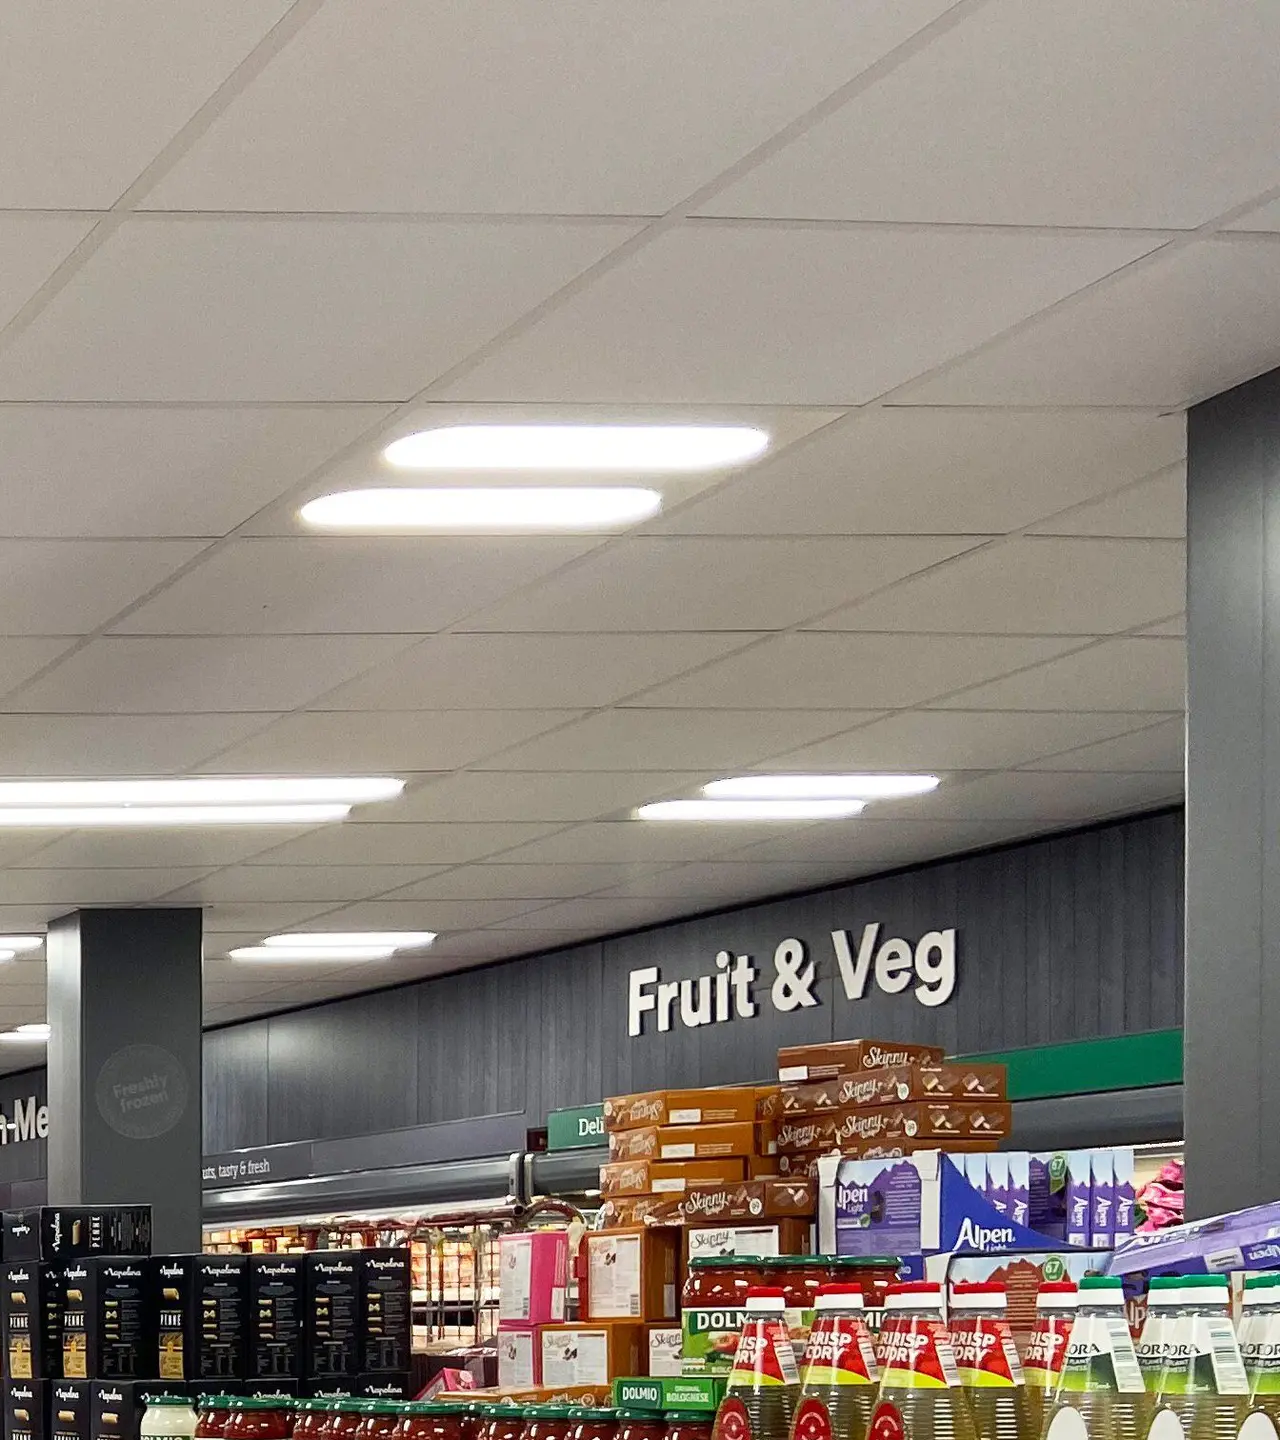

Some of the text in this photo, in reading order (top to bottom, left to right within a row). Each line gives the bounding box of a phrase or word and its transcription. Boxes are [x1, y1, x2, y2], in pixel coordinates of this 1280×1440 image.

[628, 921, 957, 1037] Fruit & Veg
[863, 1046, 915, 1068] Skinny
[112, 1073, 168, 1099] Freshly
[840, 1079, 882, 1102] Skinny
[120, 1089, 170, 1114] frozen
[778, 1124, 820, 1147] Skinny
[842, 1113, 887, 1138] Skinny
[202, 1164, 217, 1181] uts,
[218, 1162, 239, 1179] tasty
[248, 1159, 270, 1175] fresh
[686, 1191, 731, 1215] Skinny
[1073, 1196, 1089, 1227] Alpen
[1096, 1196, 1112, 1227] Alpen
[1118, 1195, 1133, 1226] Alpen
[92, 1215, 101, 1249] PENNE
[691, 1230, 731, 1248] Skinny
[953, 1217, 1015, 1251] Alpen
[201, 1265, 240, 1277] Napolina
[257, 1264, 296, 1277] Napolina
[314, 1261, 353, 1276] Napolina
[365, 1257, 404, 1272] Napolina
[9, 1315, 29, 1329] PENNE
[64, 1314, 85, 1328] PENNE
[160, 1313, 182, 1327] PENNE
[622, 1387, 657, 1402] DOLMIO
